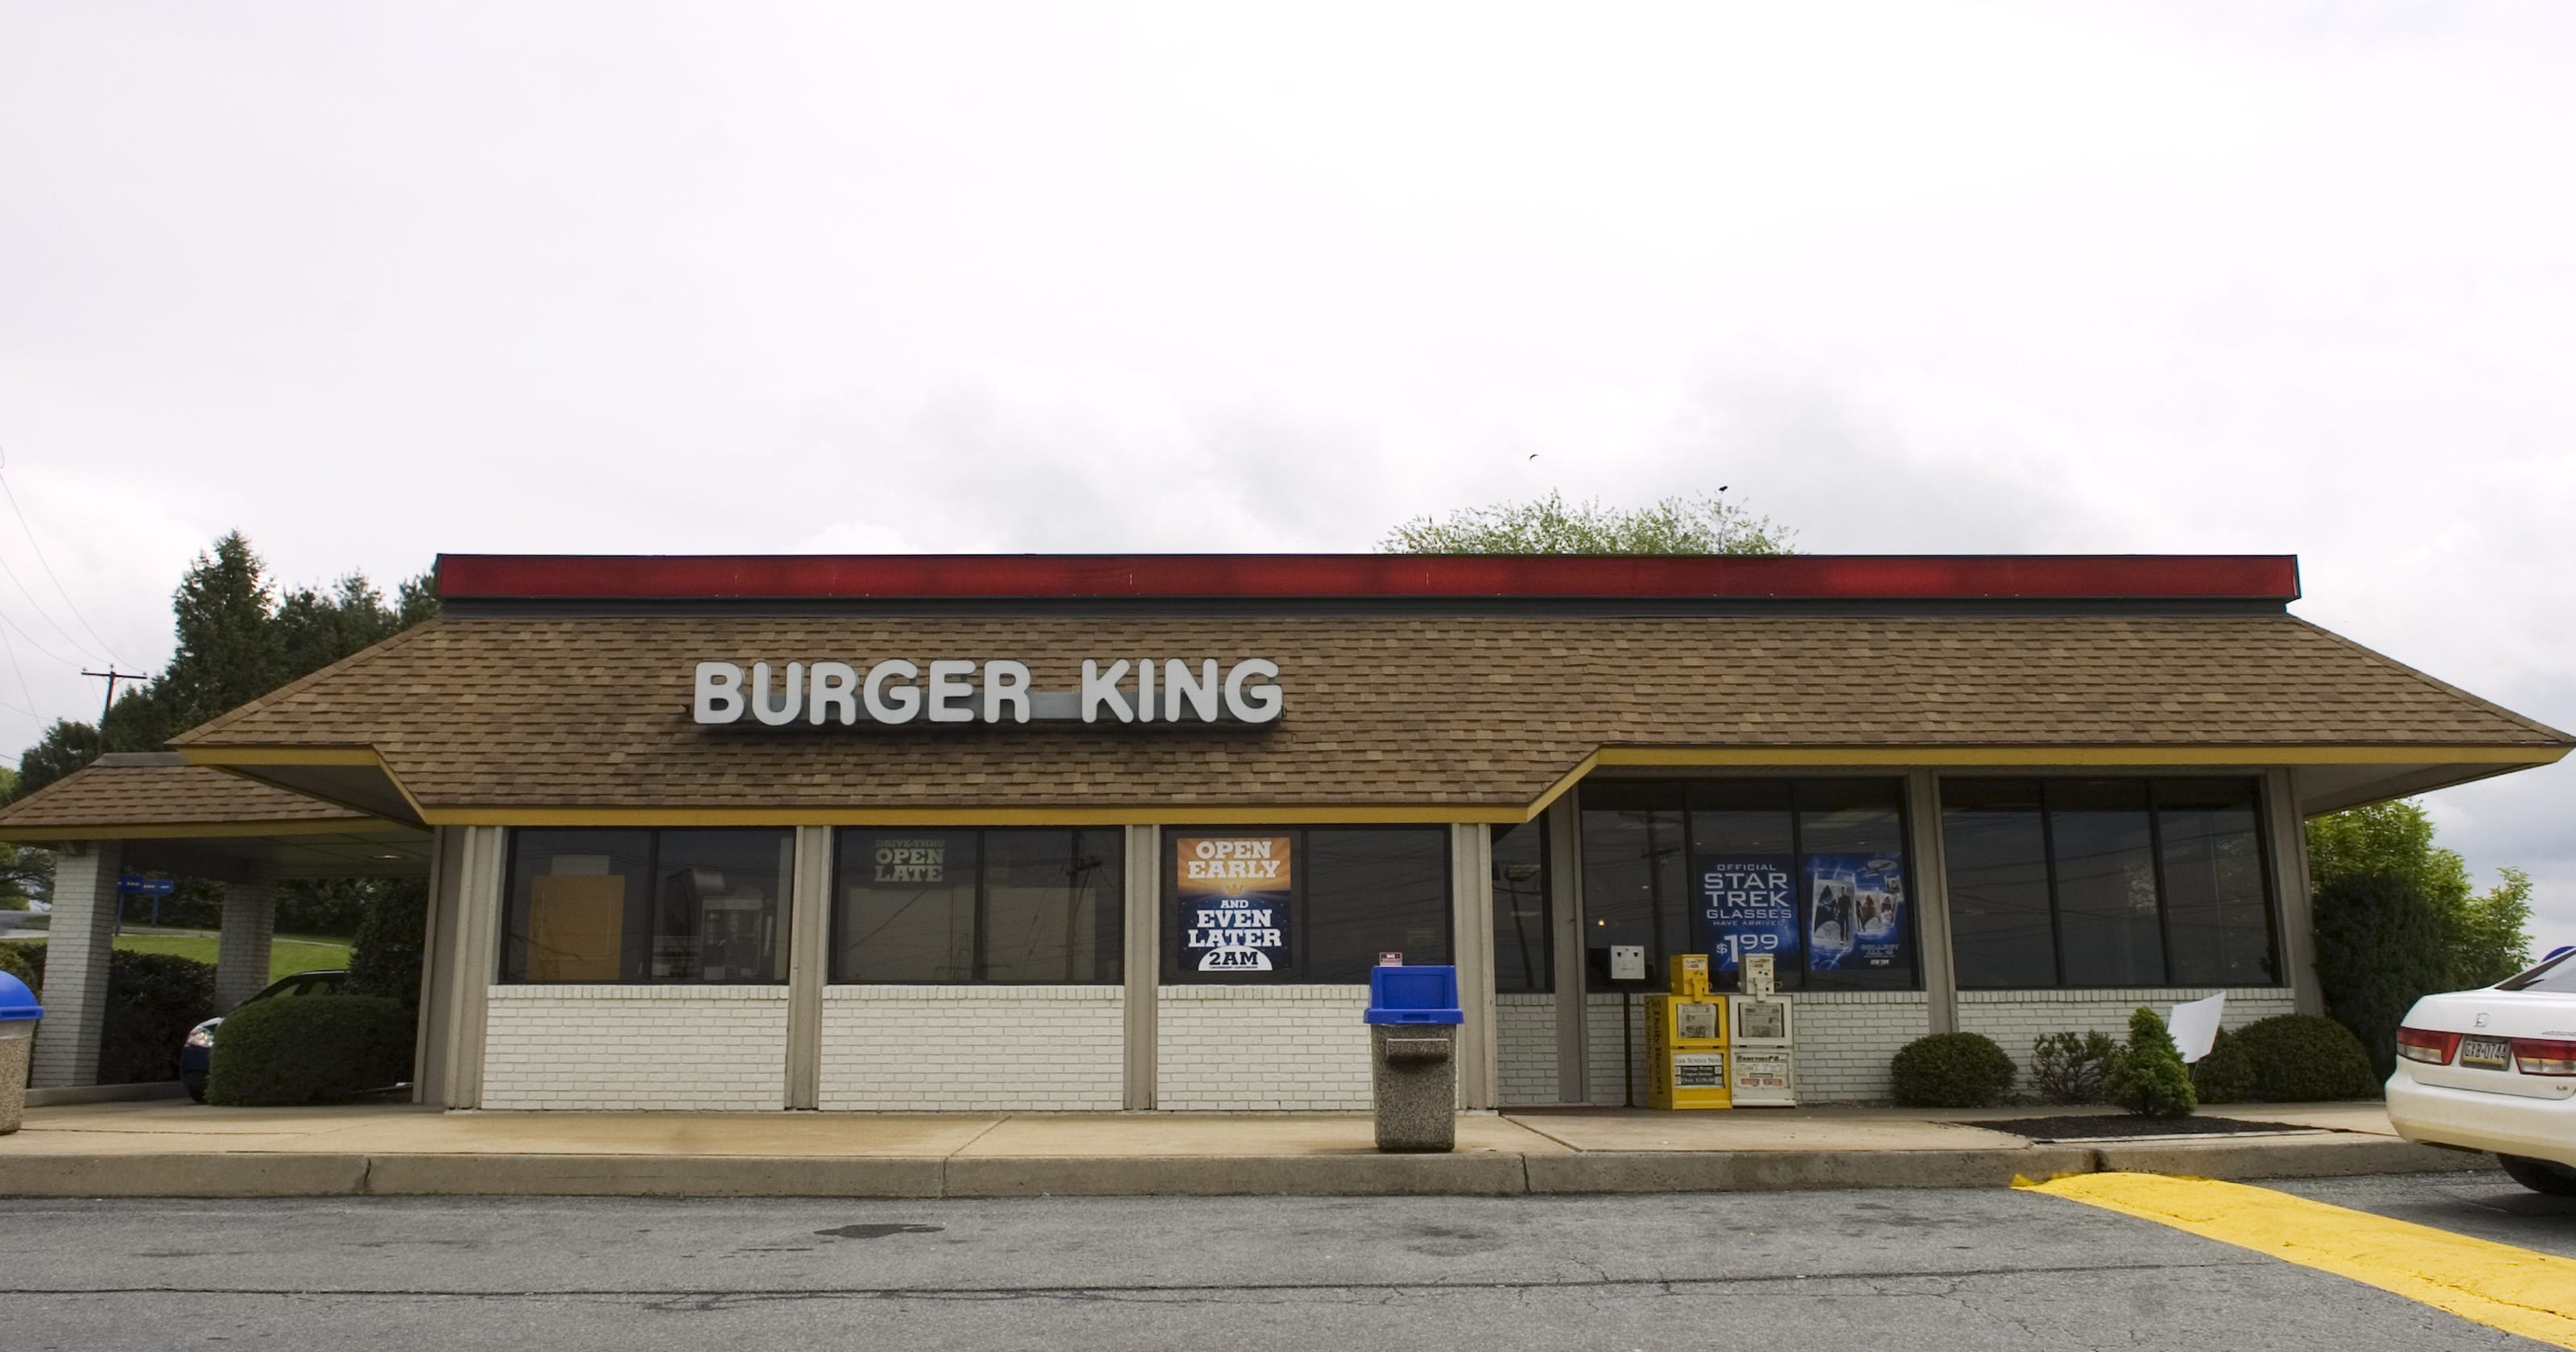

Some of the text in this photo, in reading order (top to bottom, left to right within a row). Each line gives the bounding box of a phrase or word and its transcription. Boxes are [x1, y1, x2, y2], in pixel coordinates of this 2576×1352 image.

[693, 657, 1283, 726] BURGER KING
[875, 839, 945, 847] DRIVE-THRU
[1195, 841, 1272, 859] OPEN
[875, 848, 945, 864] OPEN
[874, 865, 943, 882] LATE
[1188, 860, 1281, 879] EARLY
[1704, 873, 1789, 889] STAR
[1220, 900, 1249, 909] AND
[1705, 891, 1790, 907] TREK
[1196, 909, 1273, 927] EVEN
[1706, 909, 1792, 919] GLASSES
[1188, 929, 1282, 947] LATER
[1209, 952, 1259, 965] 2AM
